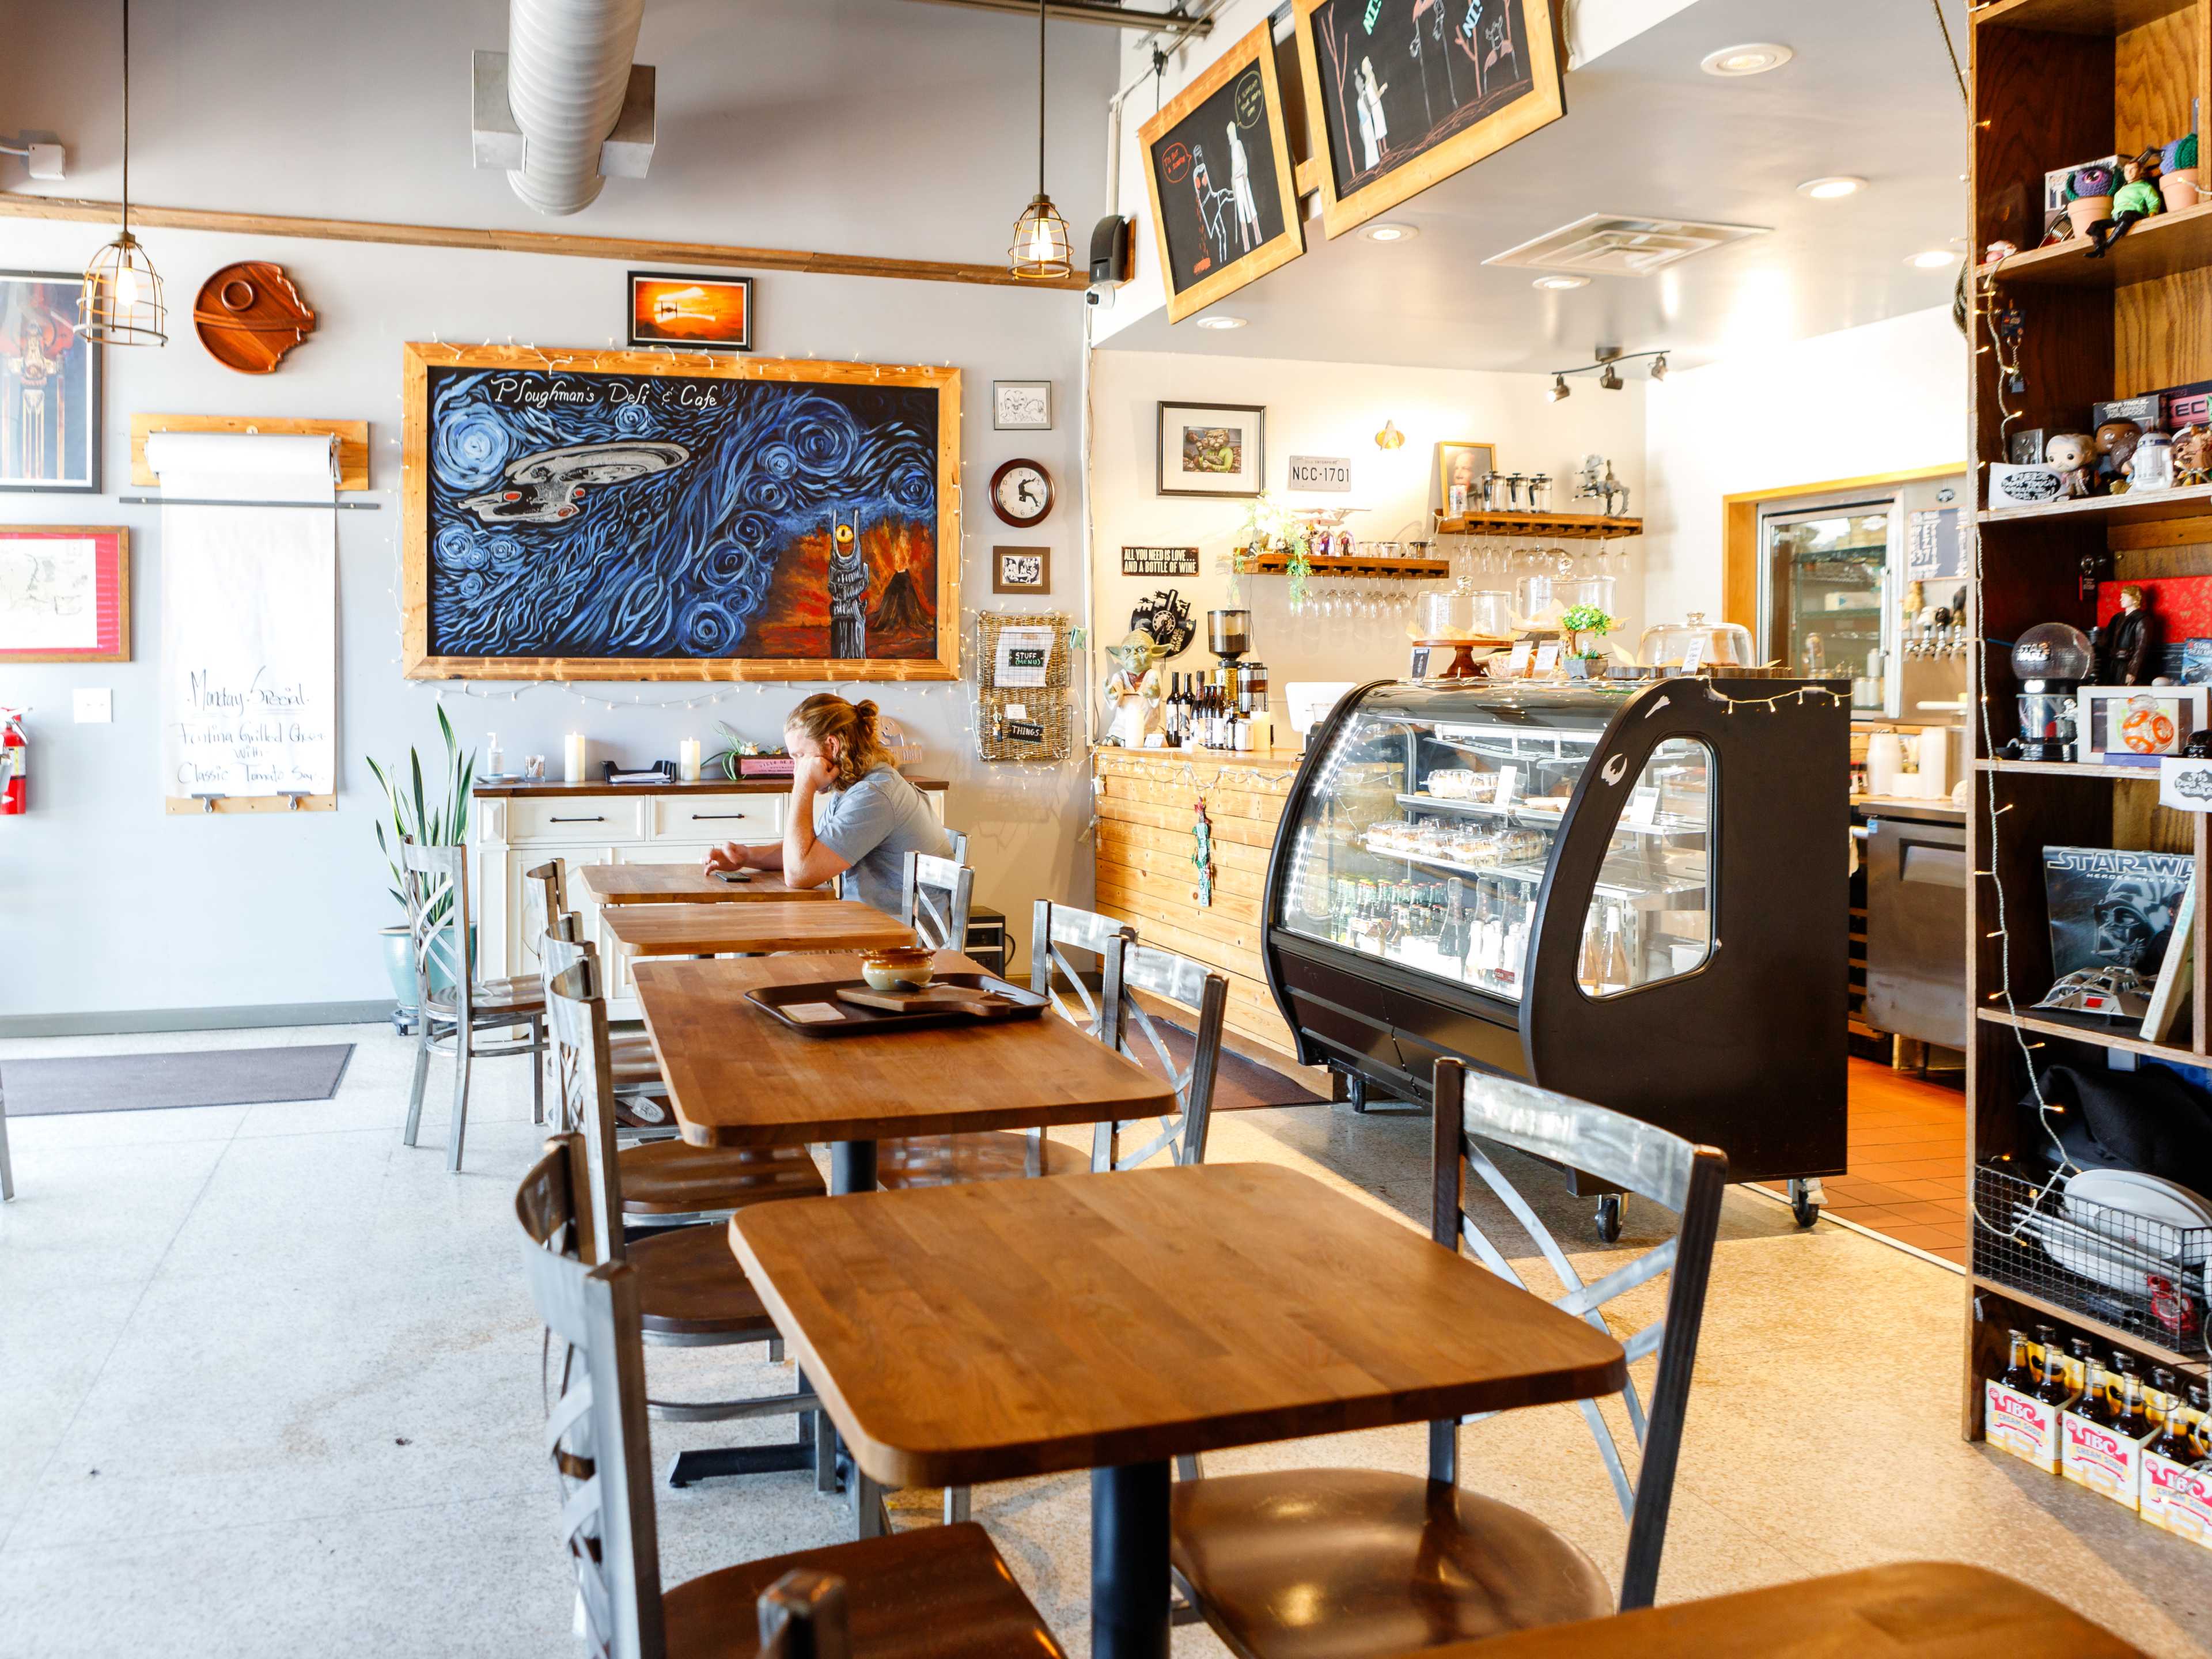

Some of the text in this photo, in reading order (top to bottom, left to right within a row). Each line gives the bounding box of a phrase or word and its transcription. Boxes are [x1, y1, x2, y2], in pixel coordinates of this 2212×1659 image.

[491, 378, 594, 408] Ploughman's
[608, 382, 649, 405] Deli
[680, 385, 718, 411] Cafe
[1293, 466, 1349, 483] NCC-1701
[1124, 548, 1135, 560] ALL
[1136, 548, 1148, 560] YOU
[1149, 549, 1164, 561] NEED
[1165, 549, 1171, 561] IS
[1124, 560, 1196, 574] AND A BOTTLE OF WINE
[1015, 652, 1037, 660] STUFF
[1012, 725, 1040, 737] THINGS
[177, 761, 230, 784] Classic
[2047, 851, 2147, 875] STAR
[2085, 873, 2130, 881] HEROES
[2006, 1399, 2033, 1422] IBC
[2085, 1431, 2115, 1456] IBC
[2168, 1473, 2201, 1499] IBC
